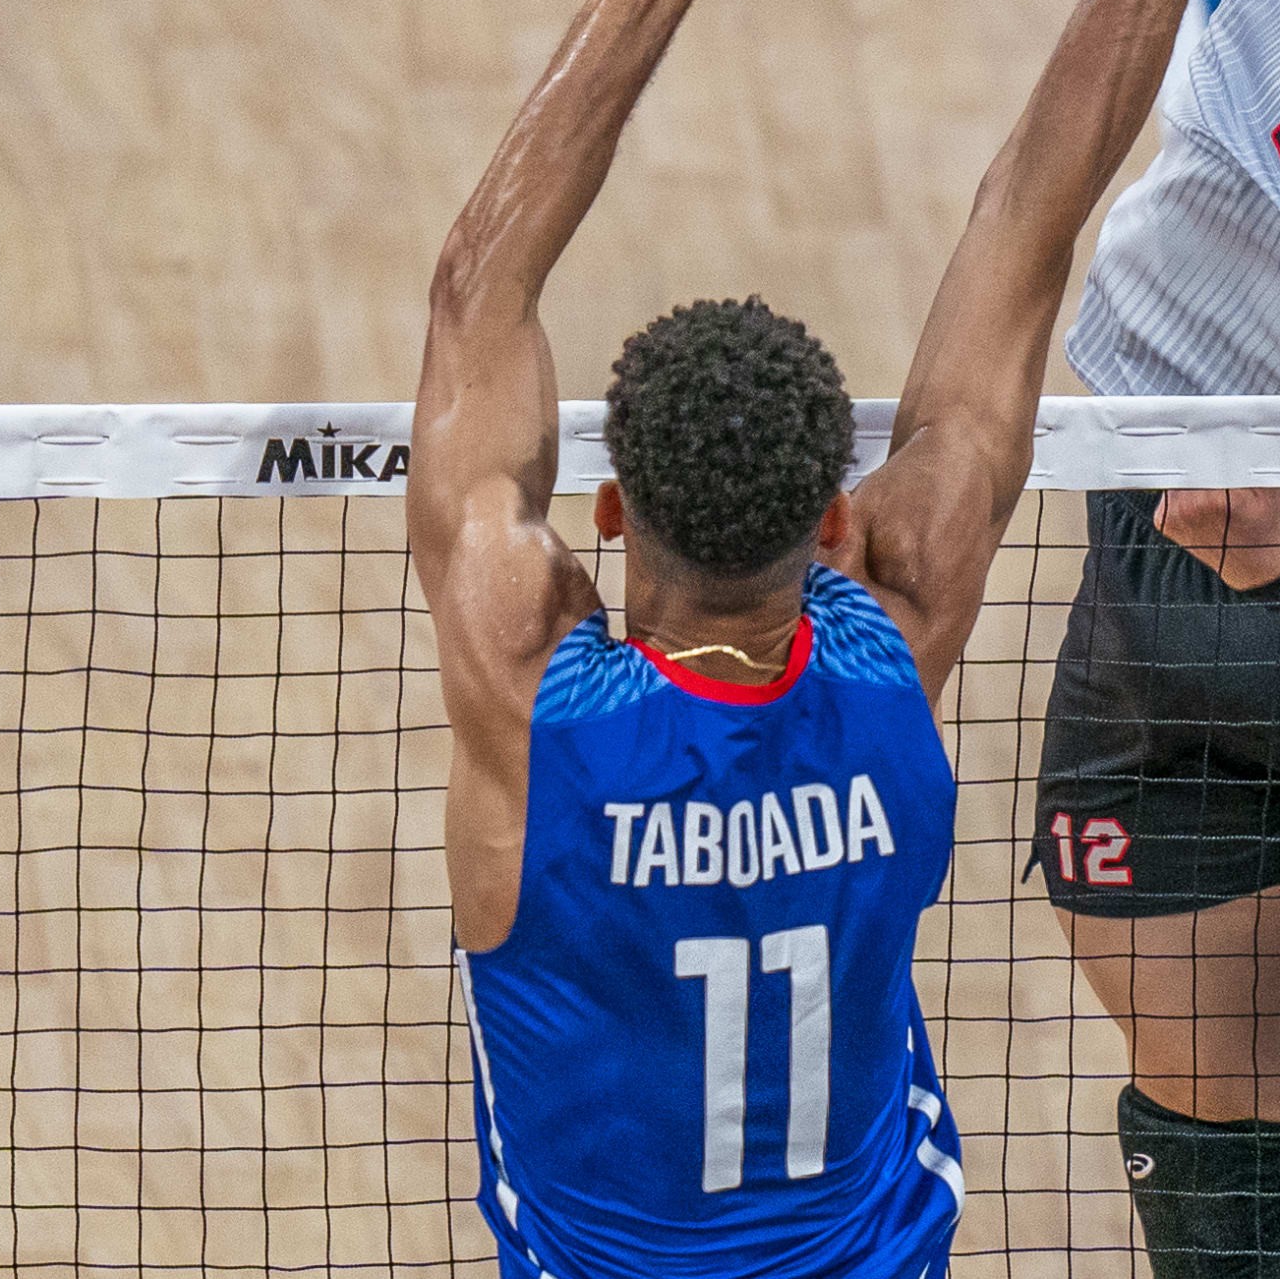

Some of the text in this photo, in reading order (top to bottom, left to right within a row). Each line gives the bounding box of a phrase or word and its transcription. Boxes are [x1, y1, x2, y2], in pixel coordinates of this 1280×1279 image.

[604, 774, 896, 888] TABOADA
[1051, 812, 1132, 885] 12
[674, 924, 830, 1194] 11
